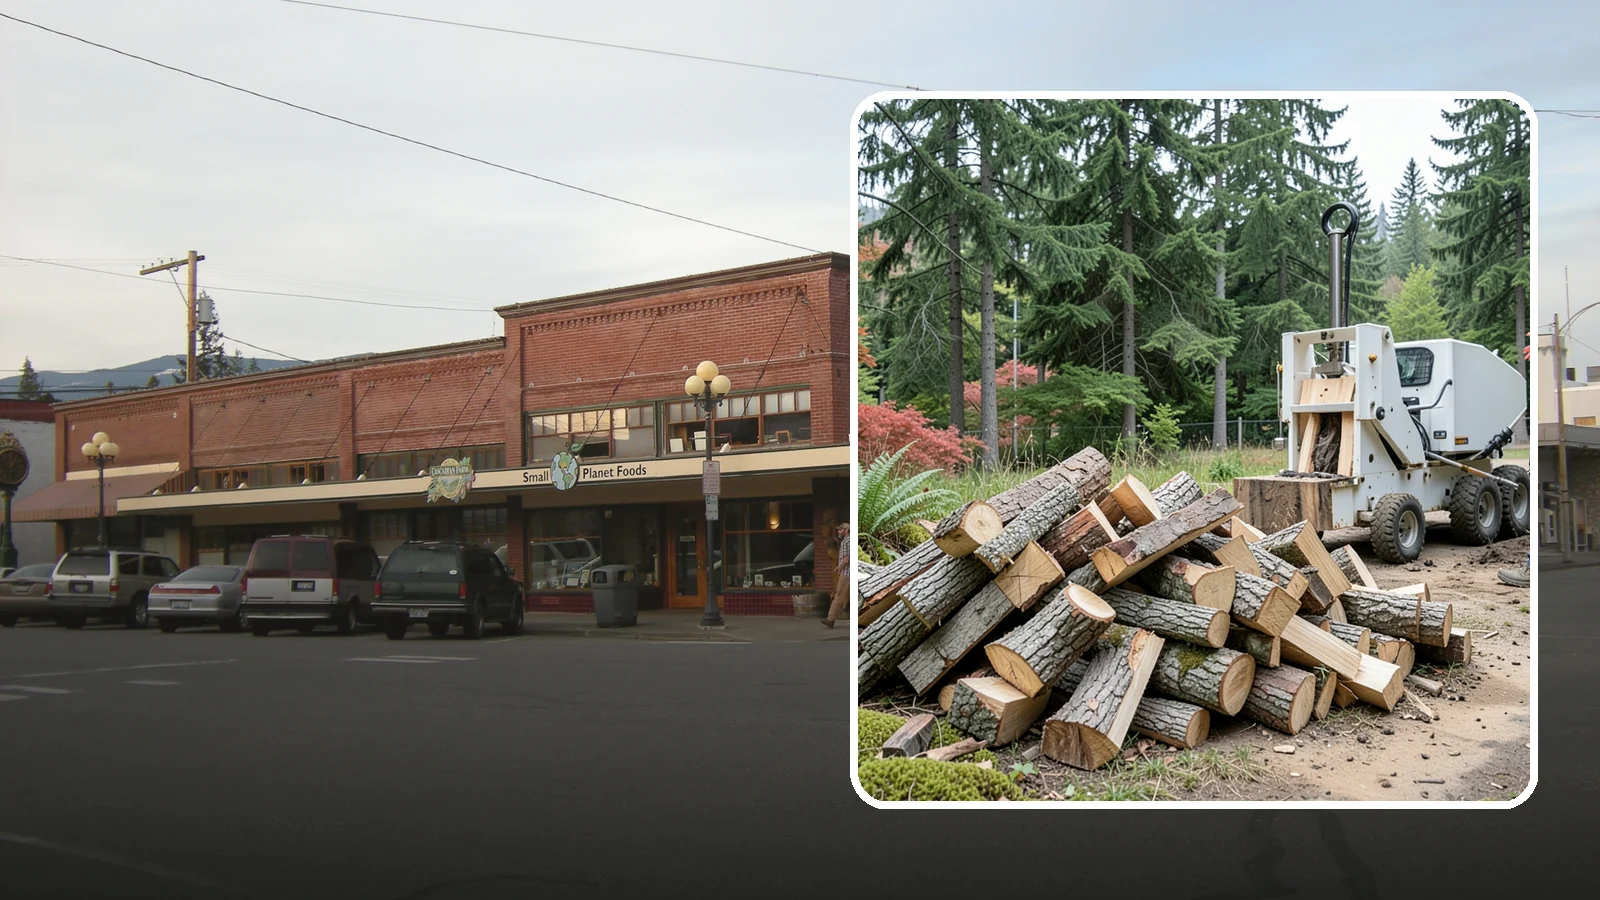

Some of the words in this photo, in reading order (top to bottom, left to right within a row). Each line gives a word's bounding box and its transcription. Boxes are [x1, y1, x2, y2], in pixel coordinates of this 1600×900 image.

[523, 471, 548, 482] Small
[583, 467, 614, 479] Planet
[617, 464, 646, 476] Foods
